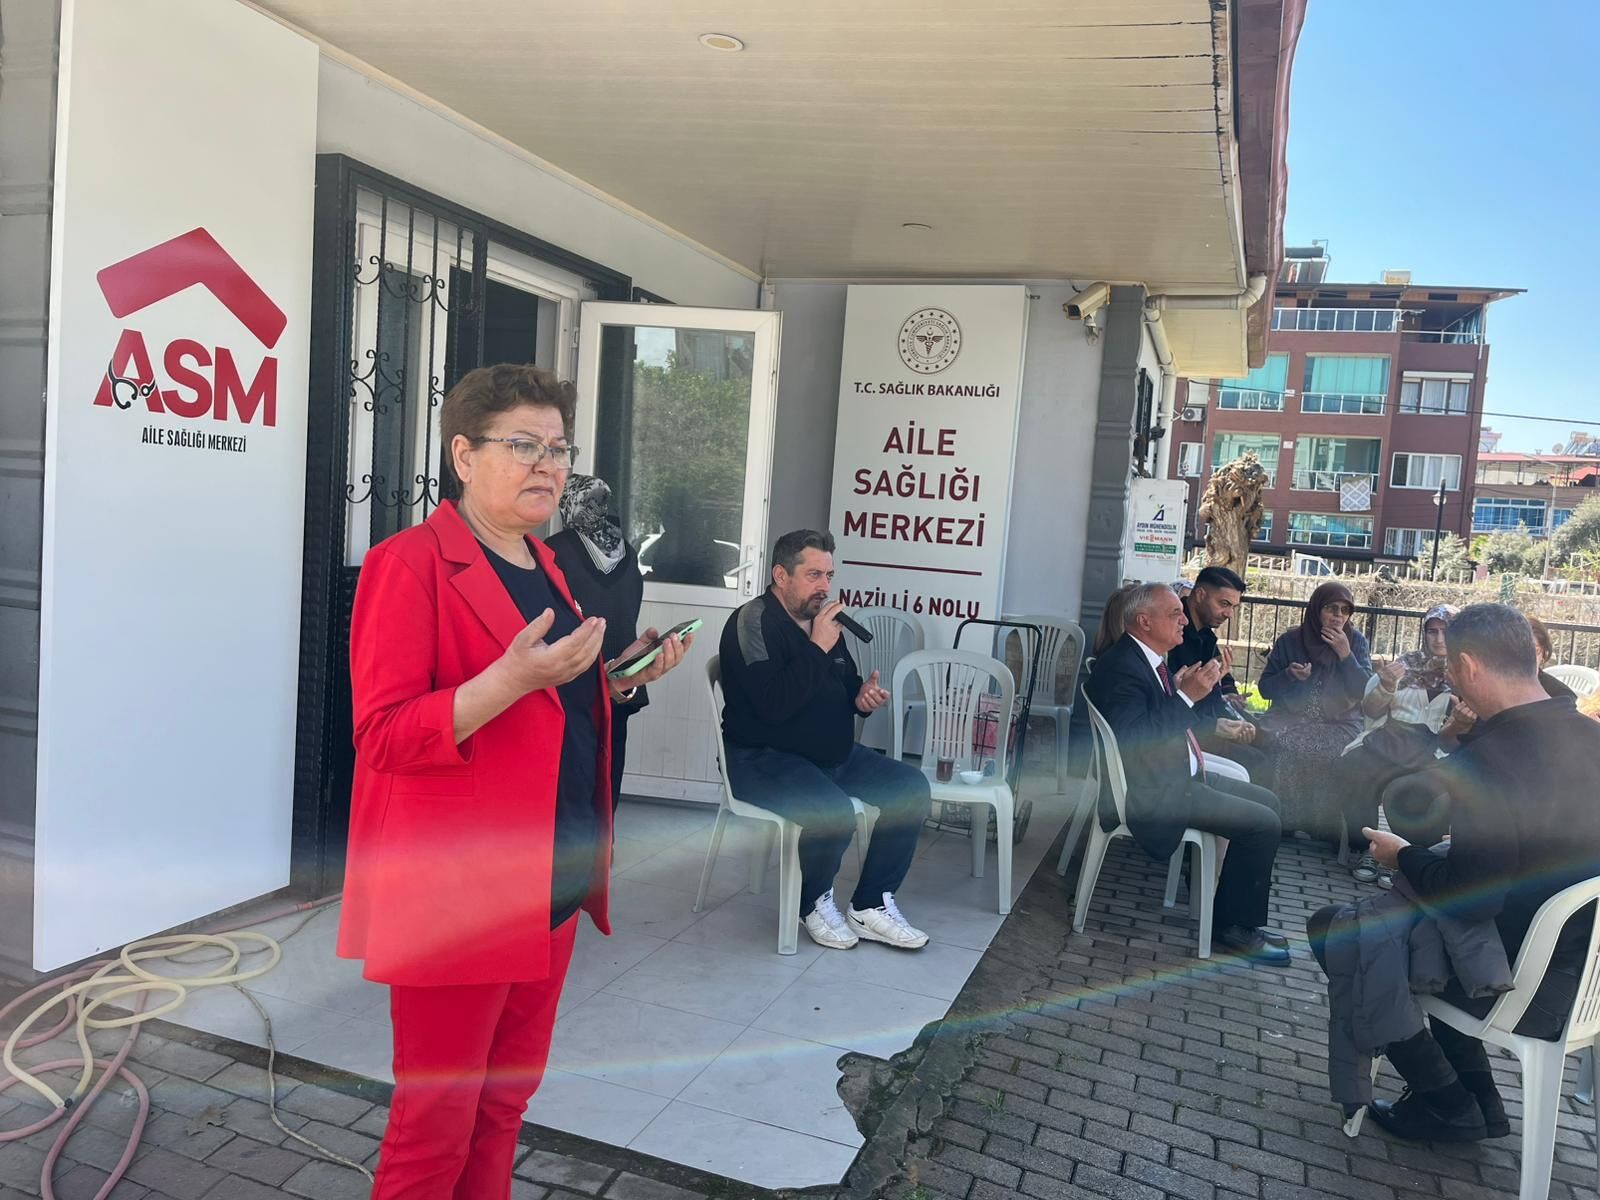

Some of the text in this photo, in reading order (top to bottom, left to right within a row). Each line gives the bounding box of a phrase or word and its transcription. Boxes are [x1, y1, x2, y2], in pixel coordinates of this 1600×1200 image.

[93, 328, 278, 427] ASM
[854, 381, 1000, 398] T.C. SAĞLIK BAKANLIĞI
[142, 425, 247, 453] AİLE SAĞLIĞI MERKEZİ
[883, 420, 957, 456] AİLE
[853, 464, 980, 502] SAĞLIĞI
[843, 511, 985, 547] MERKEZİ
[913, 596, 923, 614] 6
[928, 597, 980, 619] NOLU
